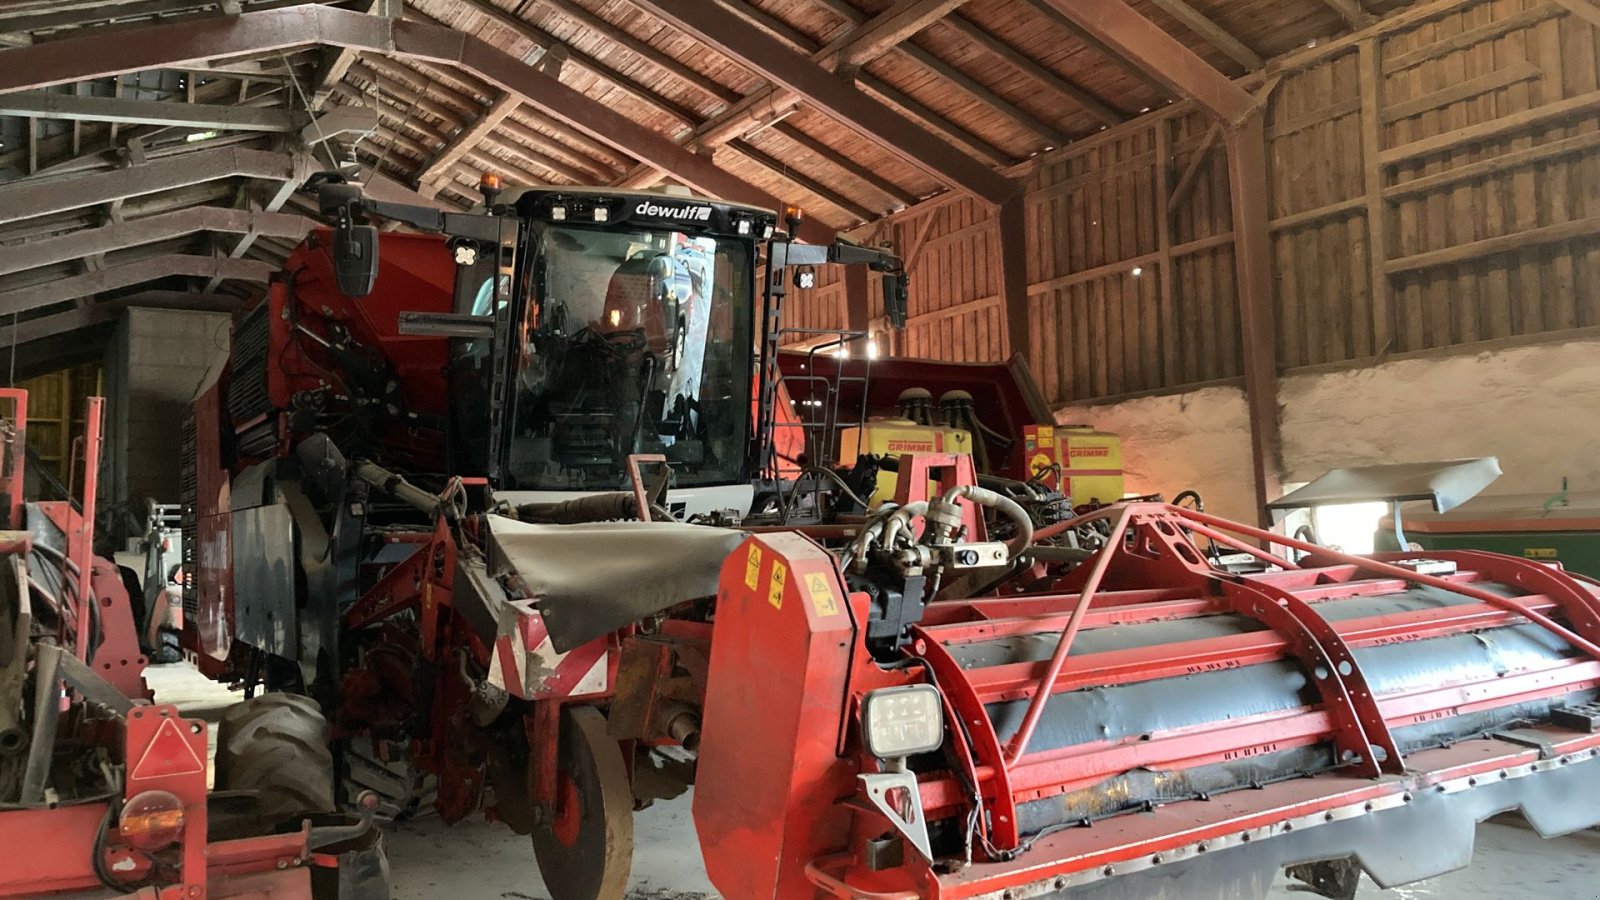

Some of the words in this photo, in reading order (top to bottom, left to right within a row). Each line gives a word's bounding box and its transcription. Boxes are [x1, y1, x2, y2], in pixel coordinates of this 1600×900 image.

[635, 201, 698, 219] dewulf
[888, 442, 933, 452] GRIMME
[1070, 448, 1109, 457] GRIMME
